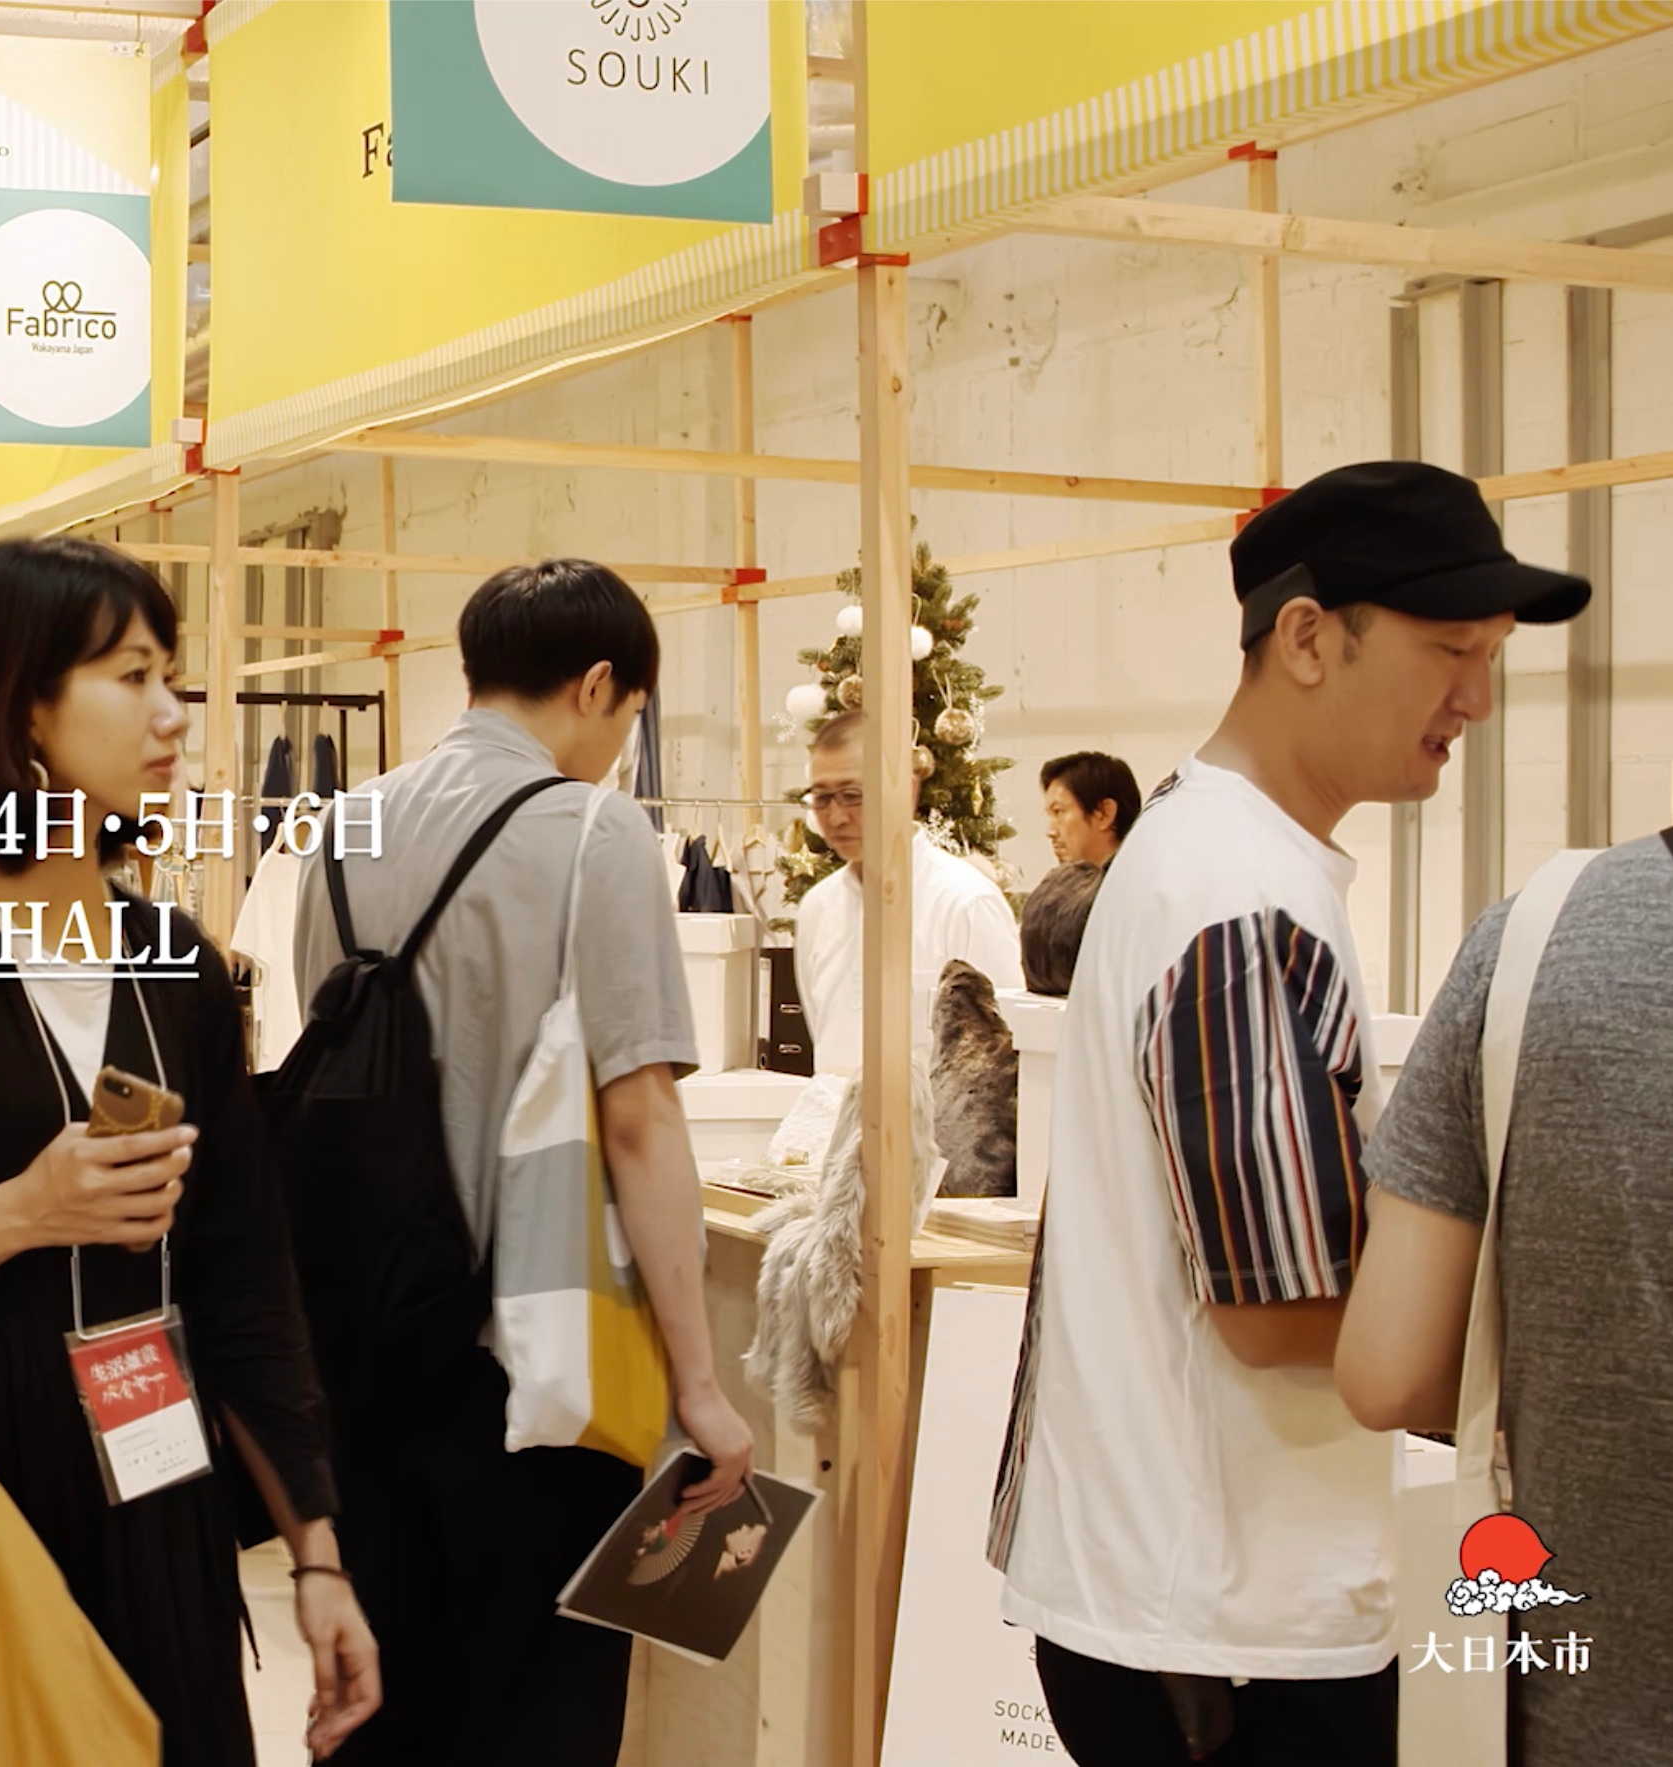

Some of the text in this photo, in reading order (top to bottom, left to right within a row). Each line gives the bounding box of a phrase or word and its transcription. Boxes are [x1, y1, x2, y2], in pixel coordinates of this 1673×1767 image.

[566, 48, 709, 95] SOUKI
[7, 306, 117, 340] Fabrico
[31, 342, 94, 356] Wakayama Japan
[1000, 1728, 1057, 1752] MADE
